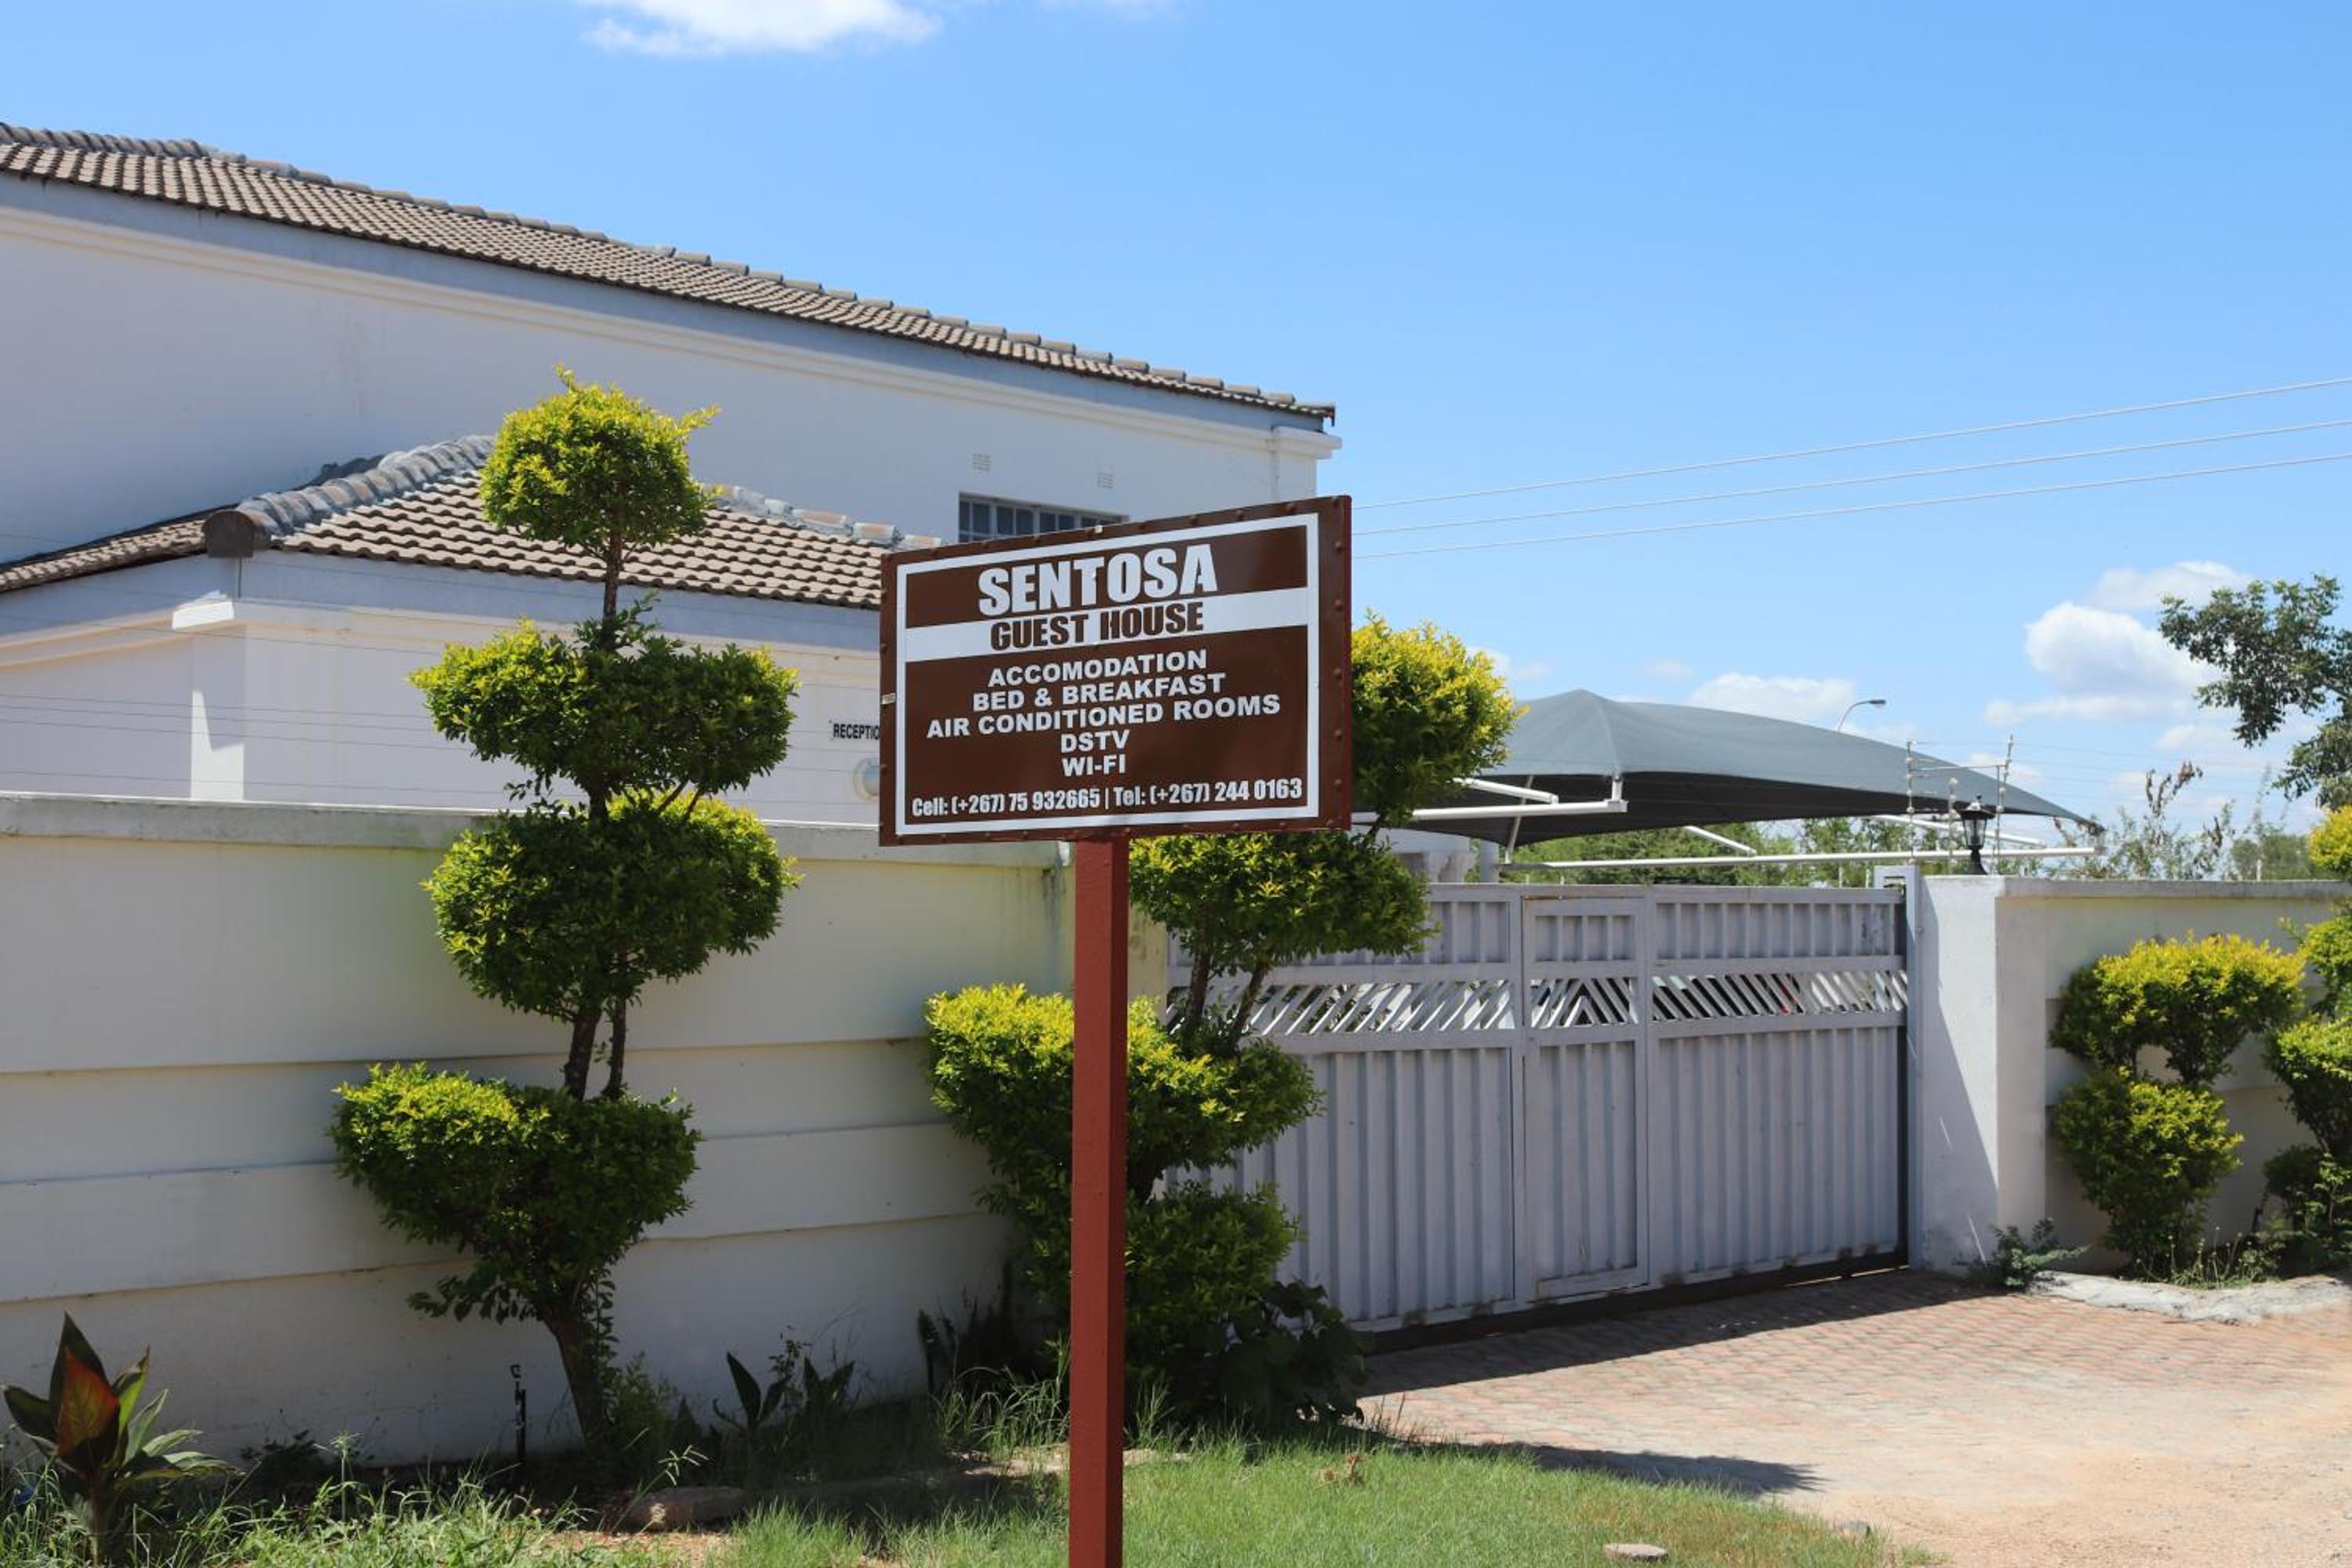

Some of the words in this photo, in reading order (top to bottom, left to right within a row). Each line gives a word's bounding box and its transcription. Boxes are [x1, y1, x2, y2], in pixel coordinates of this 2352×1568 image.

[978, 543, 1218, 616] SENTOSA
[990, 613, 1090, 652] GUEST
[1099, 601, 1204, 639] HOUSE
[987, 648, 1207, 688] ACCOMODATION
[973, 690, 1025, 712] BED
[1034, 688, 1053, 707] &
[1062, 673, 1225, 705] BREAKFAST
[926, 717, 971, 739] AIR
[978, 702, 1164, 735] CONDITIONED
[1174, 694, 1280, 720] ROOMS
[1061, 729, 1130, 753] DSTV
[1062, 753, 1126, 777] WI-FI
[912, 797, 948, 817] Cell:
[951, 793, 1004, 815] (+267)
[1008, 792, 1028, 812] 75
[1033, 787, 1100, 811] 932665
[1113, 786, 1145, 807] Tel:
[1150, 782, 1210, 805] (+267)
[1215, 781, 1250, 802] 244
[1254, 777, 1302, 800] 0163
